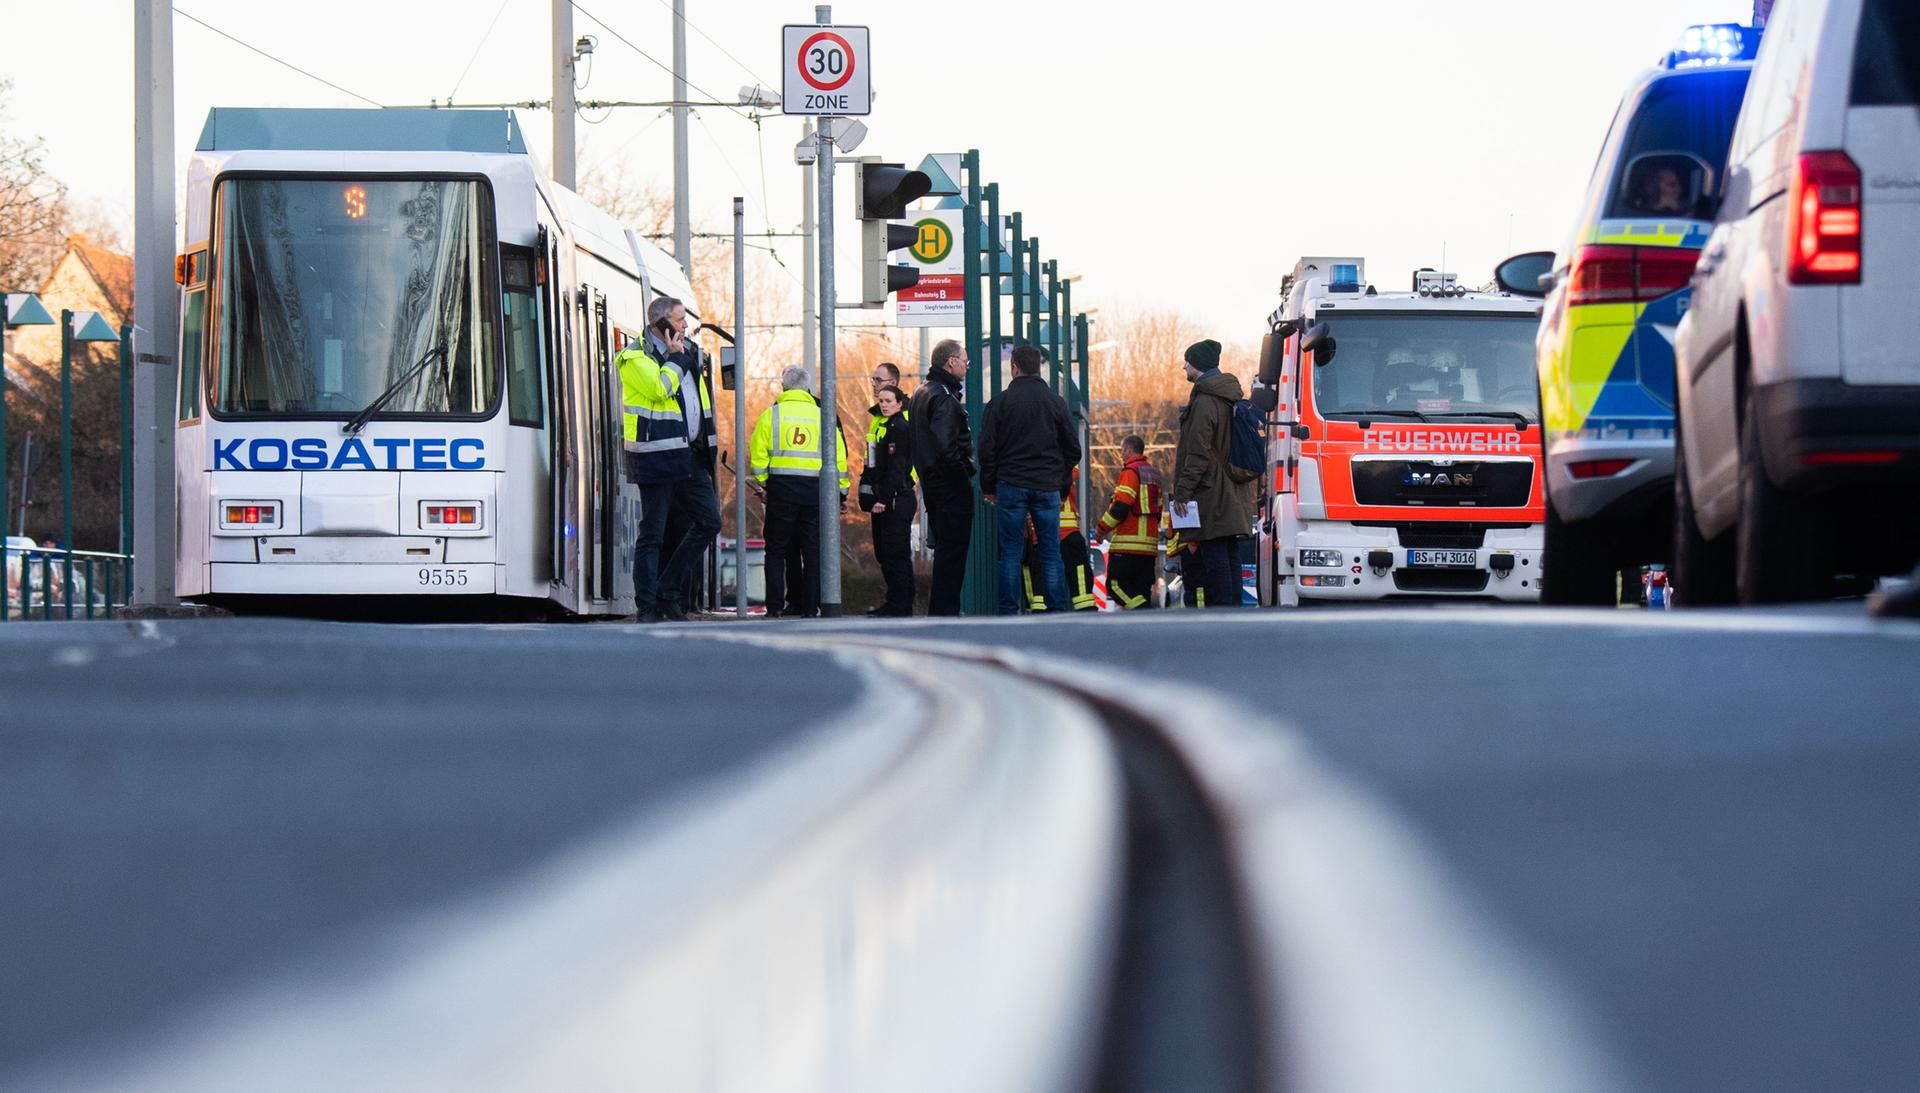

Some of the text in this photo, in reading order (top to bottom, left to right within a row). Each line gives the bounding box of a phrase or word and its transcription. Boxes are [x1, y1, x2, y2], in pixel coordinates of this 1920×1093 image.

[810, 48, 843, 75] 30
[805, 95, 848, 109] ZONE
[921, 229, 939, 253] H
[939, 290, 947, 299] B
[793, 427, 806, 445] b
[1364, 431, 1520, 452] FEUERWEHR
[214, 438, 485, 470] KOSATEC
[1412, 473, 1472, 485] MAN
[1415, 552, 1474, 564] BS FW 3016
[418, 569, 468, 588] 9555
